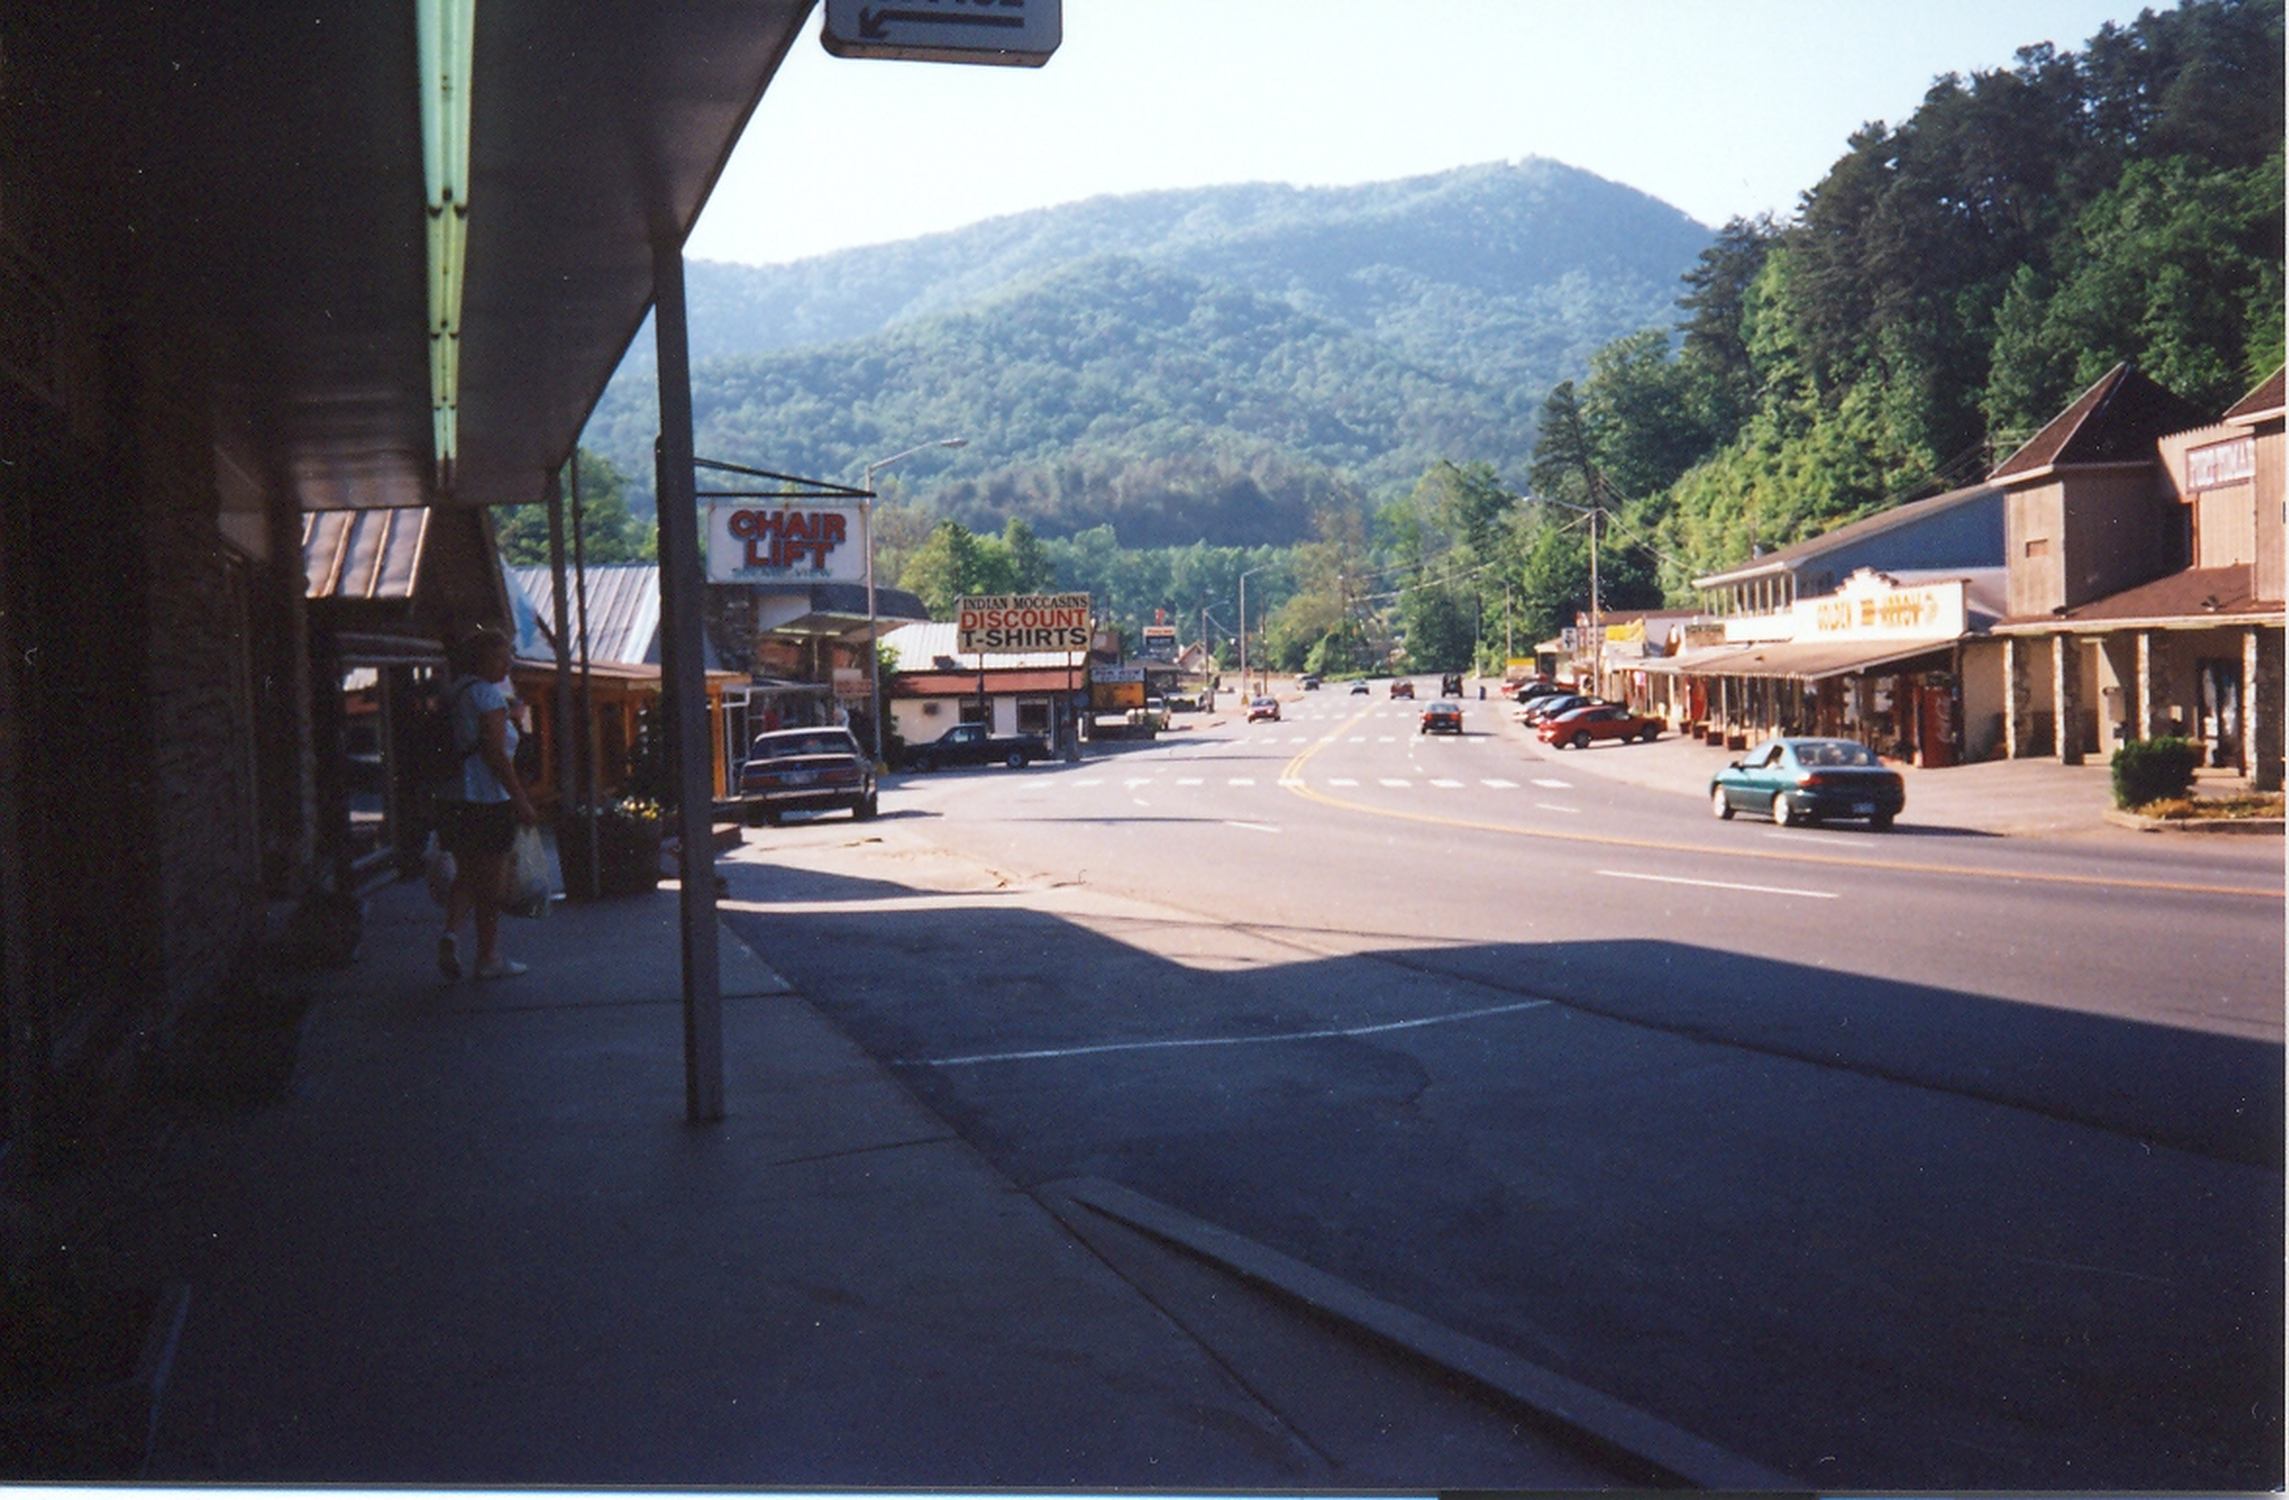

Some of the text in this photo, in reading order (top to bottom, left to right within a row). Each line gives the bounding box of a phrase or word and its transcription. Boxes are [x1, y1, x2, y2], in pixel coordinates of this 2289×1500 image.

[728, 509, 847, 543] CHAIR
[745, 539, 834, 569] LIFT
[963, 594, 1087, 610] INDIAN MOCCASINS
[961, 609, 1086, 629] DISCOUNT
[961, 627, 1088, 647] T-SHIRTS
